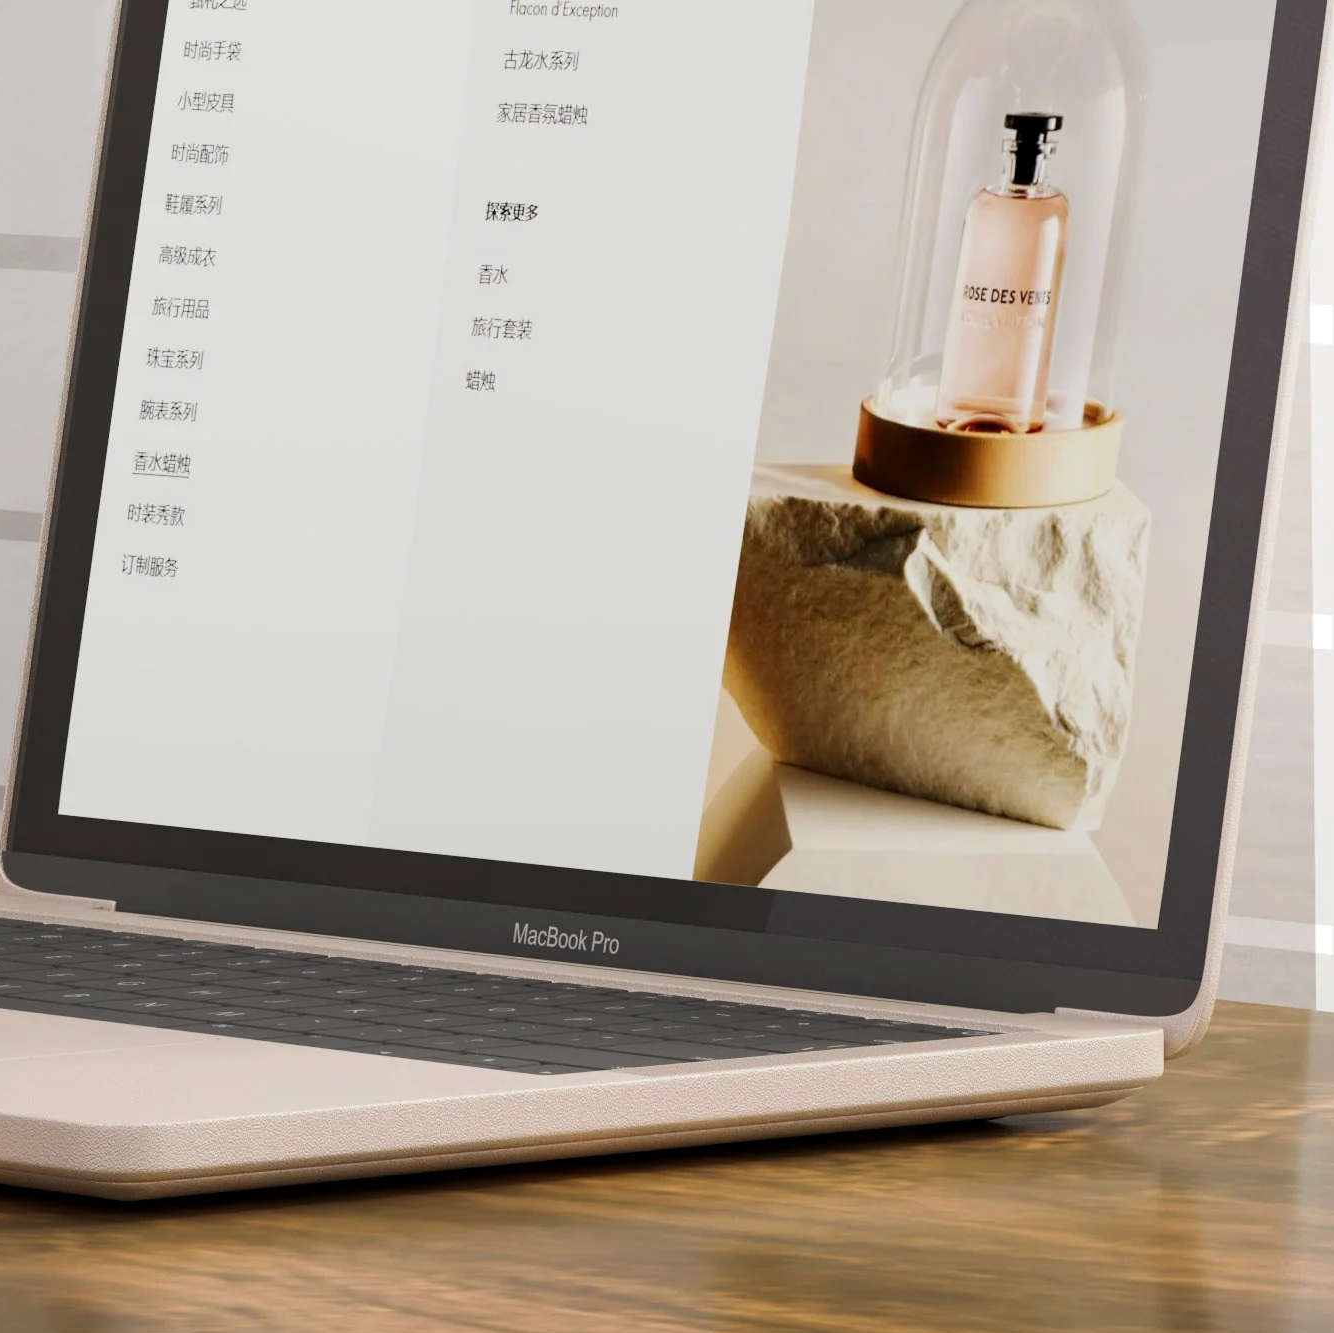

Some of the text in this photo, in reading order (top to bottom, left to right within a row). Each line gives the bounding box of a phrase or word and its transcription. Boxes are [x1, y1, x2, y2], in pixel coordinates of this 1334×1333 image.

[510, 0, 618, 21] Flacon d'Exception
[183, 40, 242, 61] 时尚手袋
[504, 50, 579, 71] 古龙水系列
[177, 91, 235, 114] 小型皮具
[497, 102, 588, 125] 家居香氛蜡烛
[171, 143, 229, 166] 时尚配饰
[164, 194, 222, 217] 鞋履系列
[485, 201, 539, 222] 探索更多
[158, 245, 216, 268] 高级成衣
[478, 265, 508, 285] 香水
[963, 285, 1051, 305] ROSE DES VENTS
[152, 297, 209, 320] 旅行用品
[471, 317, 533, 340] 旅行套装
[146, 348, 204, 371] 珠宝系列
[465, 370, 496, 392] 蜡烛
[140, 400, 198, 422] 腕表系列
[134, 451, 191, 475] 香水蜡烛
[127, 503, 185, 527] 时装秀款
[121, 554, 179, 578] 订制服务
[512, 922, 620, 955] MacBook Pro
